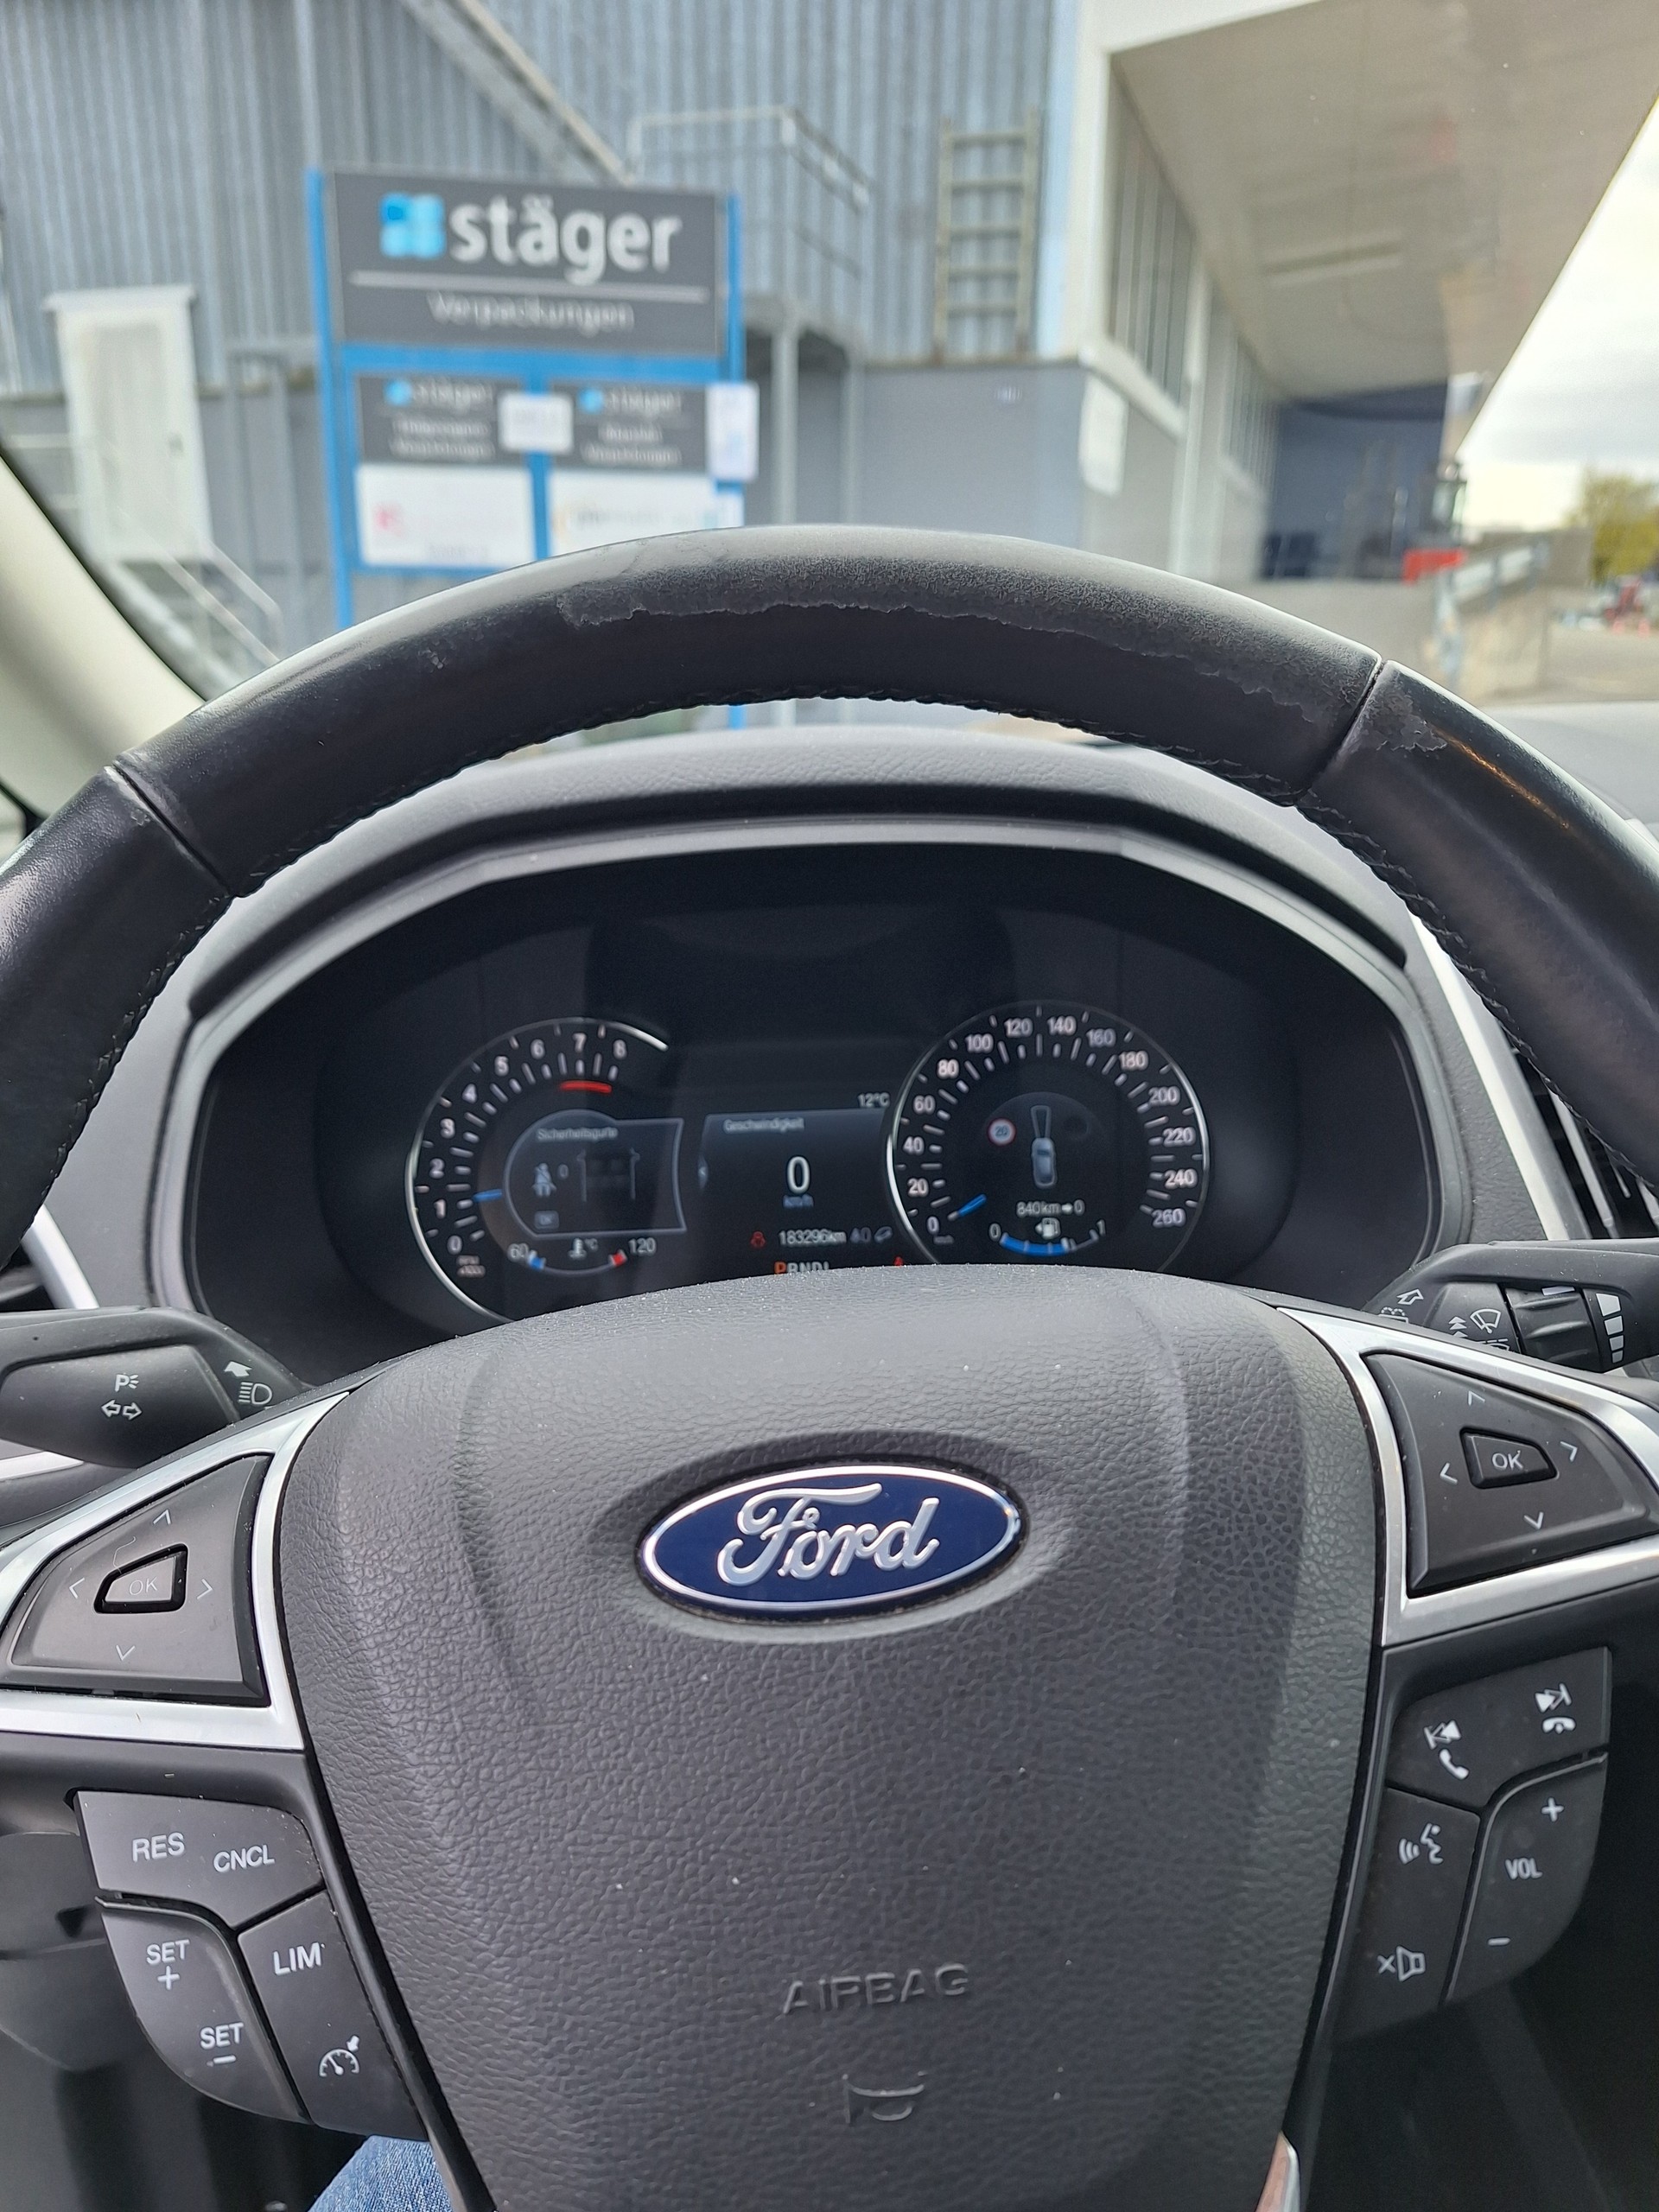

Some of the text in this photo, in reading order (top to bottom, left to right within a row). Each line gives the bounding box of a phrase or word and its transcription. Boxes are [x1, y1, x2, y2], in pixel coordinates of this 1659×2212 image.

[449, 194, 683, 286] stäger
[1005, 1019, 1032, 1038] 120
[1048, 1016, 1077, 1035] 140
[572, 1033, 588, 1052] 7
[966, 1034, 993, 1052] 100
[1087, 1029, 1116, 1046] 160
[531, 1039, 545, 1058] 6
[613, 1039, 627, 1058] 8
[495, 1056, 509, 1077] 5
[938, 1059, 959, 1078] 80
[1120, 1052, 1147, 1070] 180
[462, 1084, 478, 1103] 4
[858, 1093, 890, 1108] 12°C
[1148, 1086, 1179, 1106] 200
[913, 1095, 935, 1114] 60
[441, 1118, 454, 1138] 3
[1163, 1128, 1195, 1146] 220
[903, 1137, 924, 1154] 40
[429, 1159, 445, 1179] 2
[786, 1155, 810, 1193] 0
[1165, 1169, 1197, 1188] 240
[907, 1178, 928, 1197] 20
[434, 1199, 447, 1218] 1
[1152, 1208, 1185, 1227] 260
[927, 1217, 939, 1235] 0
[989, 1223, 1001, 1240] 0
[448, 1235, 462, 1254] 0
[509, 1243, 528, 1259] 60
[628, 1238, 655, 1255] 120
[1491, 1451, 1523, 1471] OK
[717, 1483, 939, 1586] Ford
[129, 1576, 157, 1597] OK
[131, 1832, 186, 1863] RES
[213, 1845, 275, 1873] CNCL
[1505, 1858, 1542, 1880] VOL
[145, 1939, 190, 1965] SET
[272, 1942, 322, 1976] LIM
[782, 1962, 969, 2014] AIRBAG
[200, 2022, 245, 2050] SET
